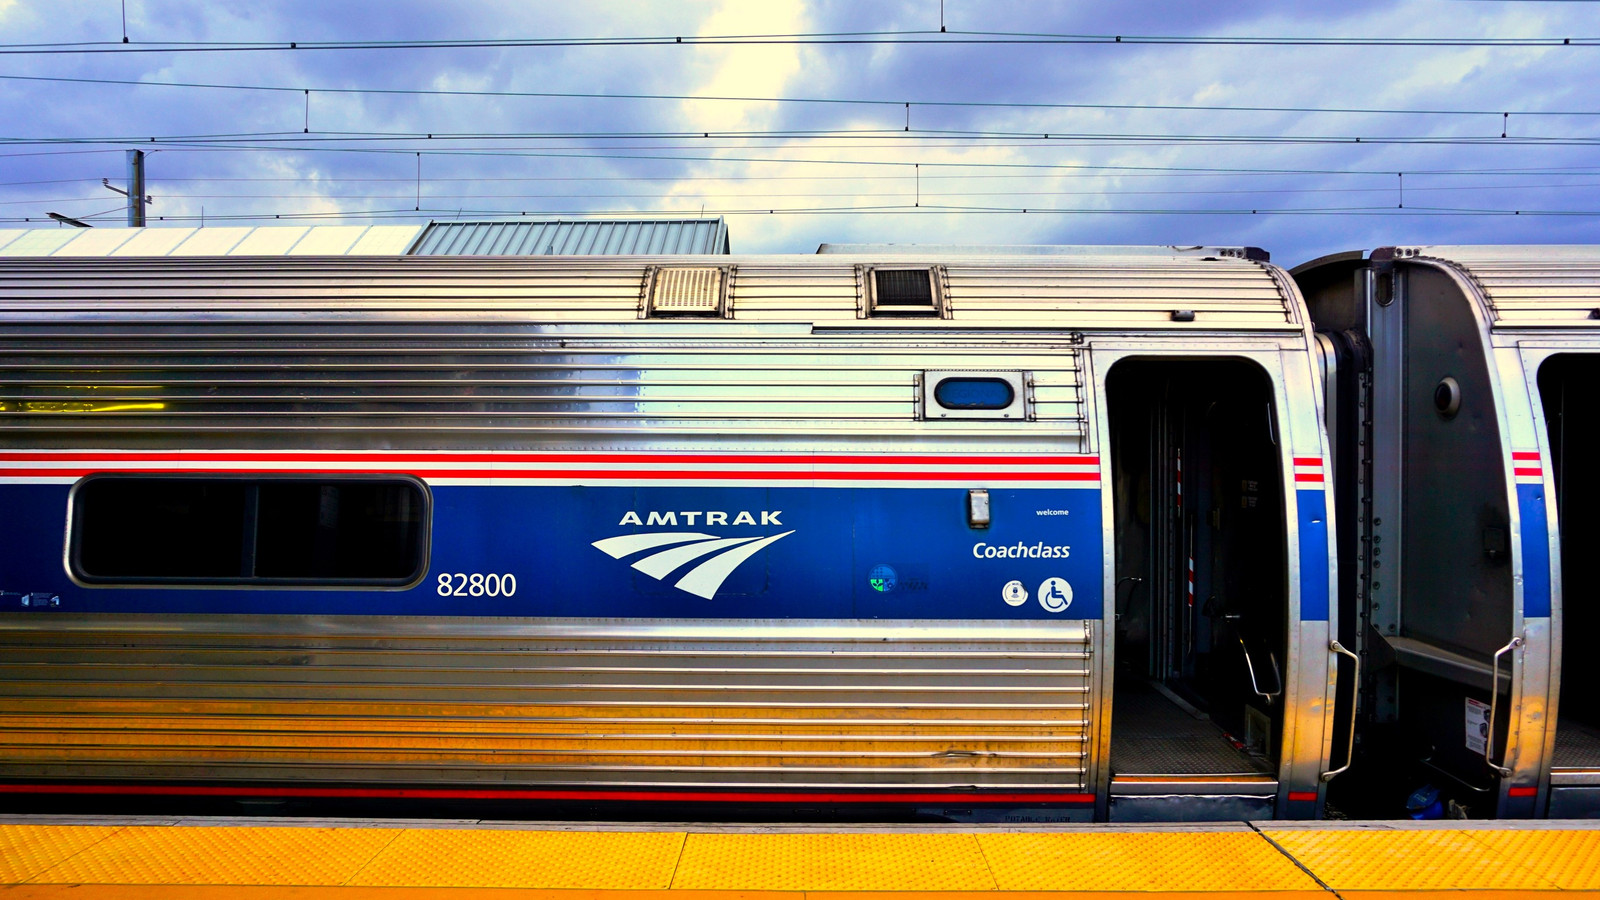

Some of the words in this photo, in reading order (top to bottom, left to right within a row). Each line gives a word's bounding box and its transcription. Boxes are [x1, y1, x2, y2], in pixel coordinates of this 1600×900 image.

[619, 510, 783, 526] AMTRAK
[1036, 508, 1069, 516] welcome
[972, 541, 1071, 559] Coachclass
[436, 573, 517, 597] 82800
